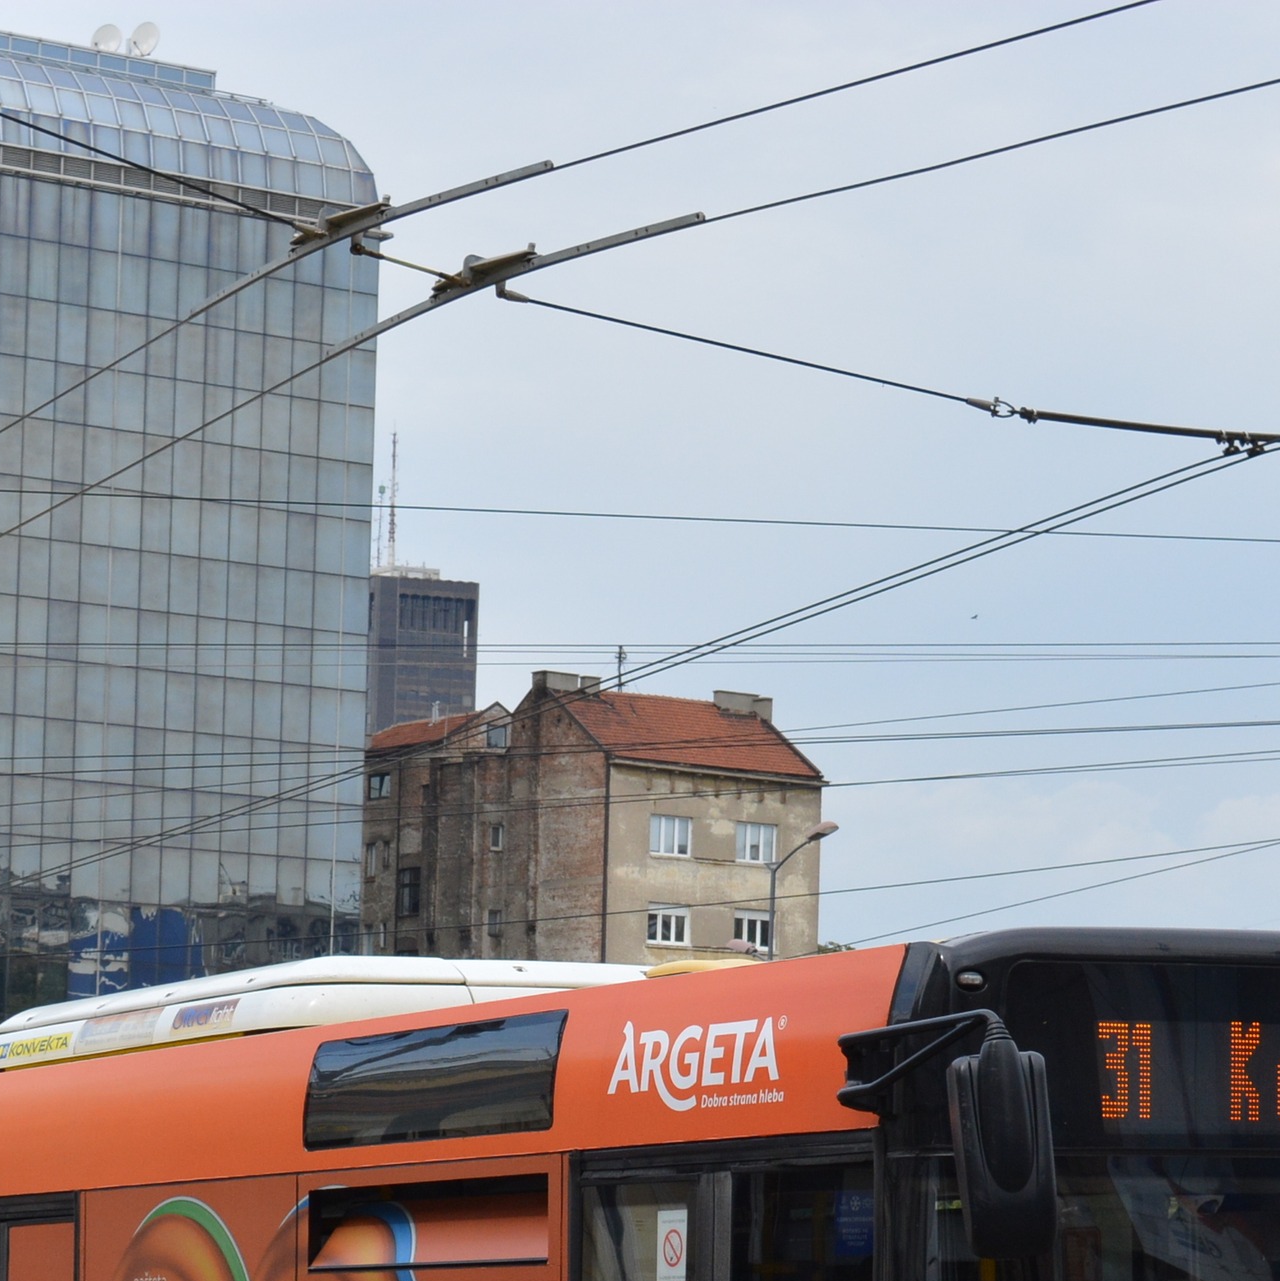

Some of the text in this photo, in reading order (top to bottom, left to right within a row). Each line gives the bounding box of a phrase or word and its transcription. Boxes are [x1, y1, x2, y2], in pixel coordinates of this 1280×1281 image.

[8, 1034, 69, 1059] KONVEKTA
[607, 1016, 781, 1112] ARGETA
[1098, 1021, 1152, 1120] 31
[701, 1087, 785, 1109] Dobra strana hleba
